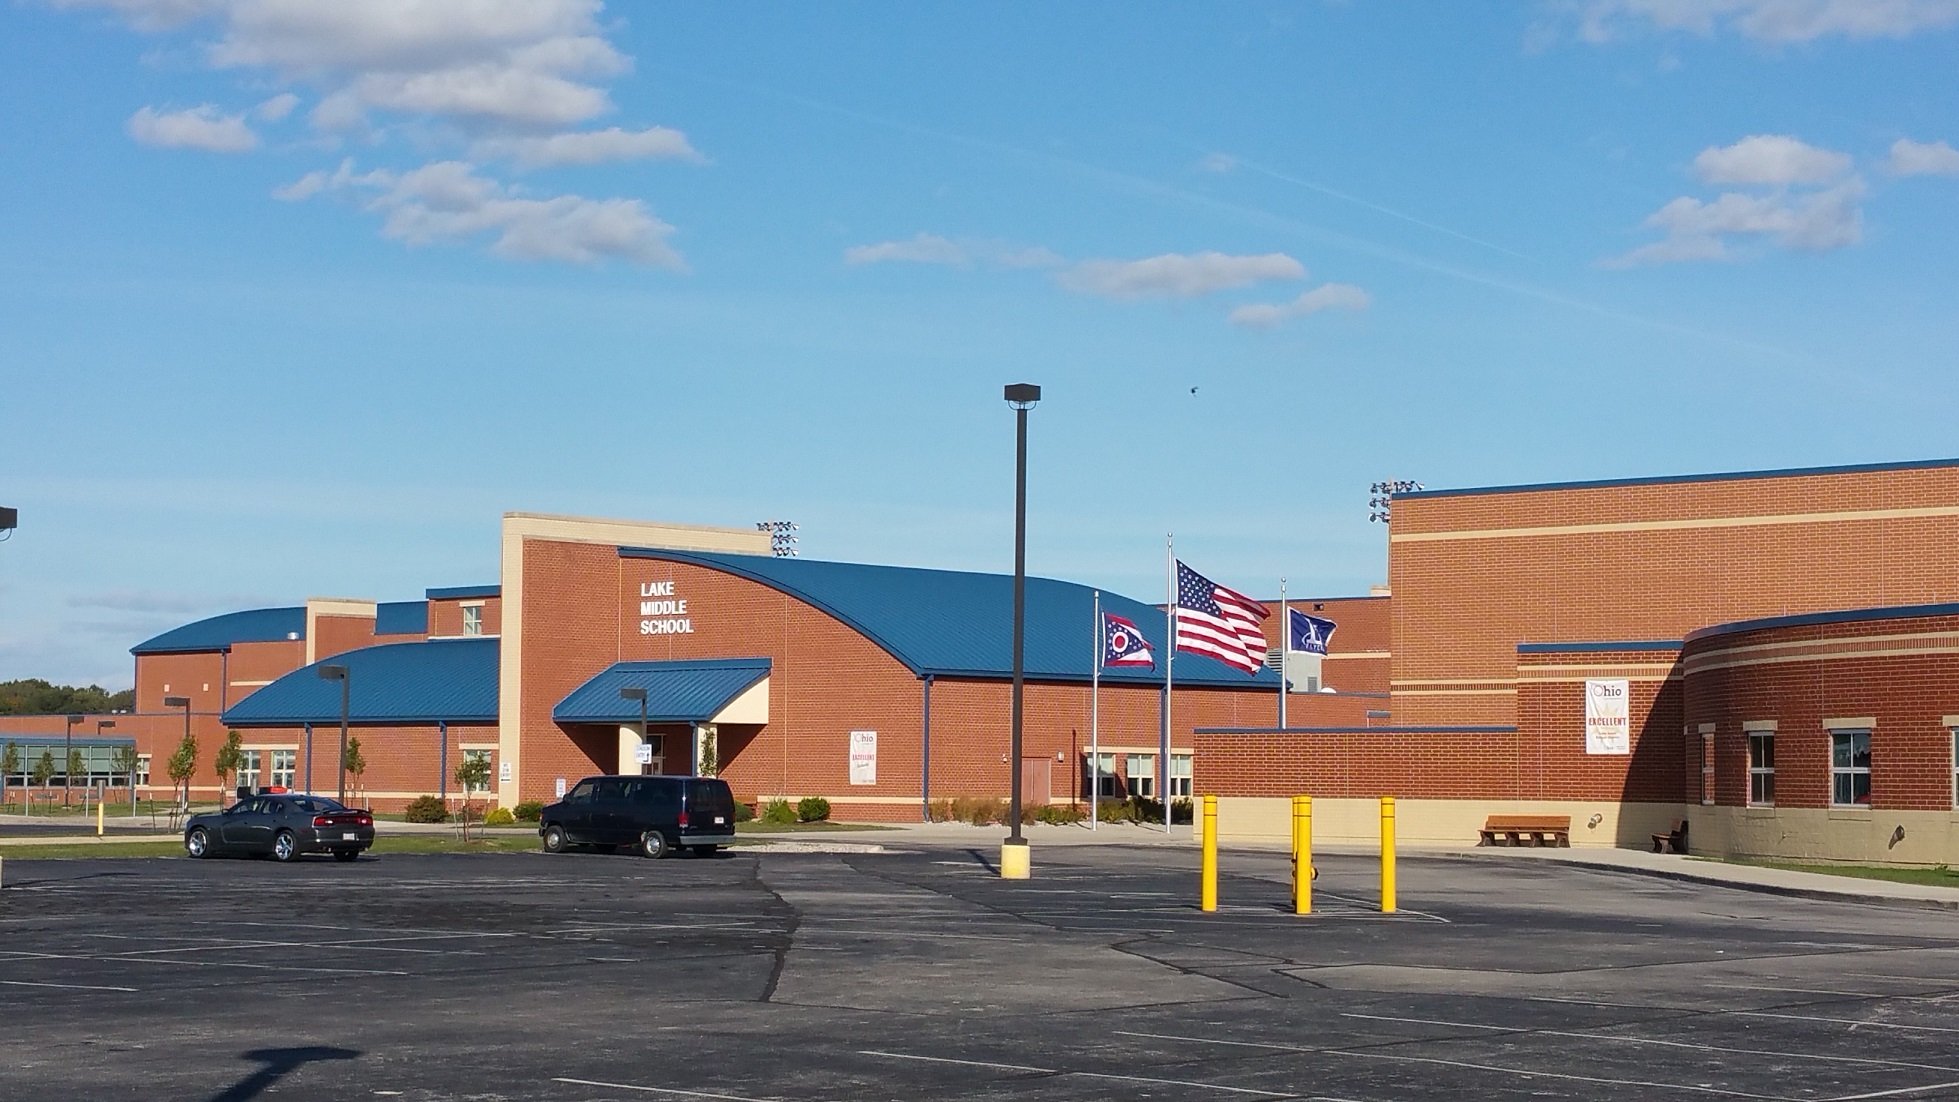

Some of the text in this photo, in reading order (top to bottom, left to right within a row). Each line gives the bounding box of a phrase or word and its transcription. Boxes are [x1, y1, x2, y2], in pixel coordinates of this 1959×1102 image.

[641, 582, 674, 597] LAKE
[641, 600, 687, 616] MIDDLE
[641, 619, 694, 635] SCHOOL
[1593, 685, 1622, 697] Ohio
[1588, 717, 1626, 726] EXCELLENT
[854, 733, 874, 743] Ohio
